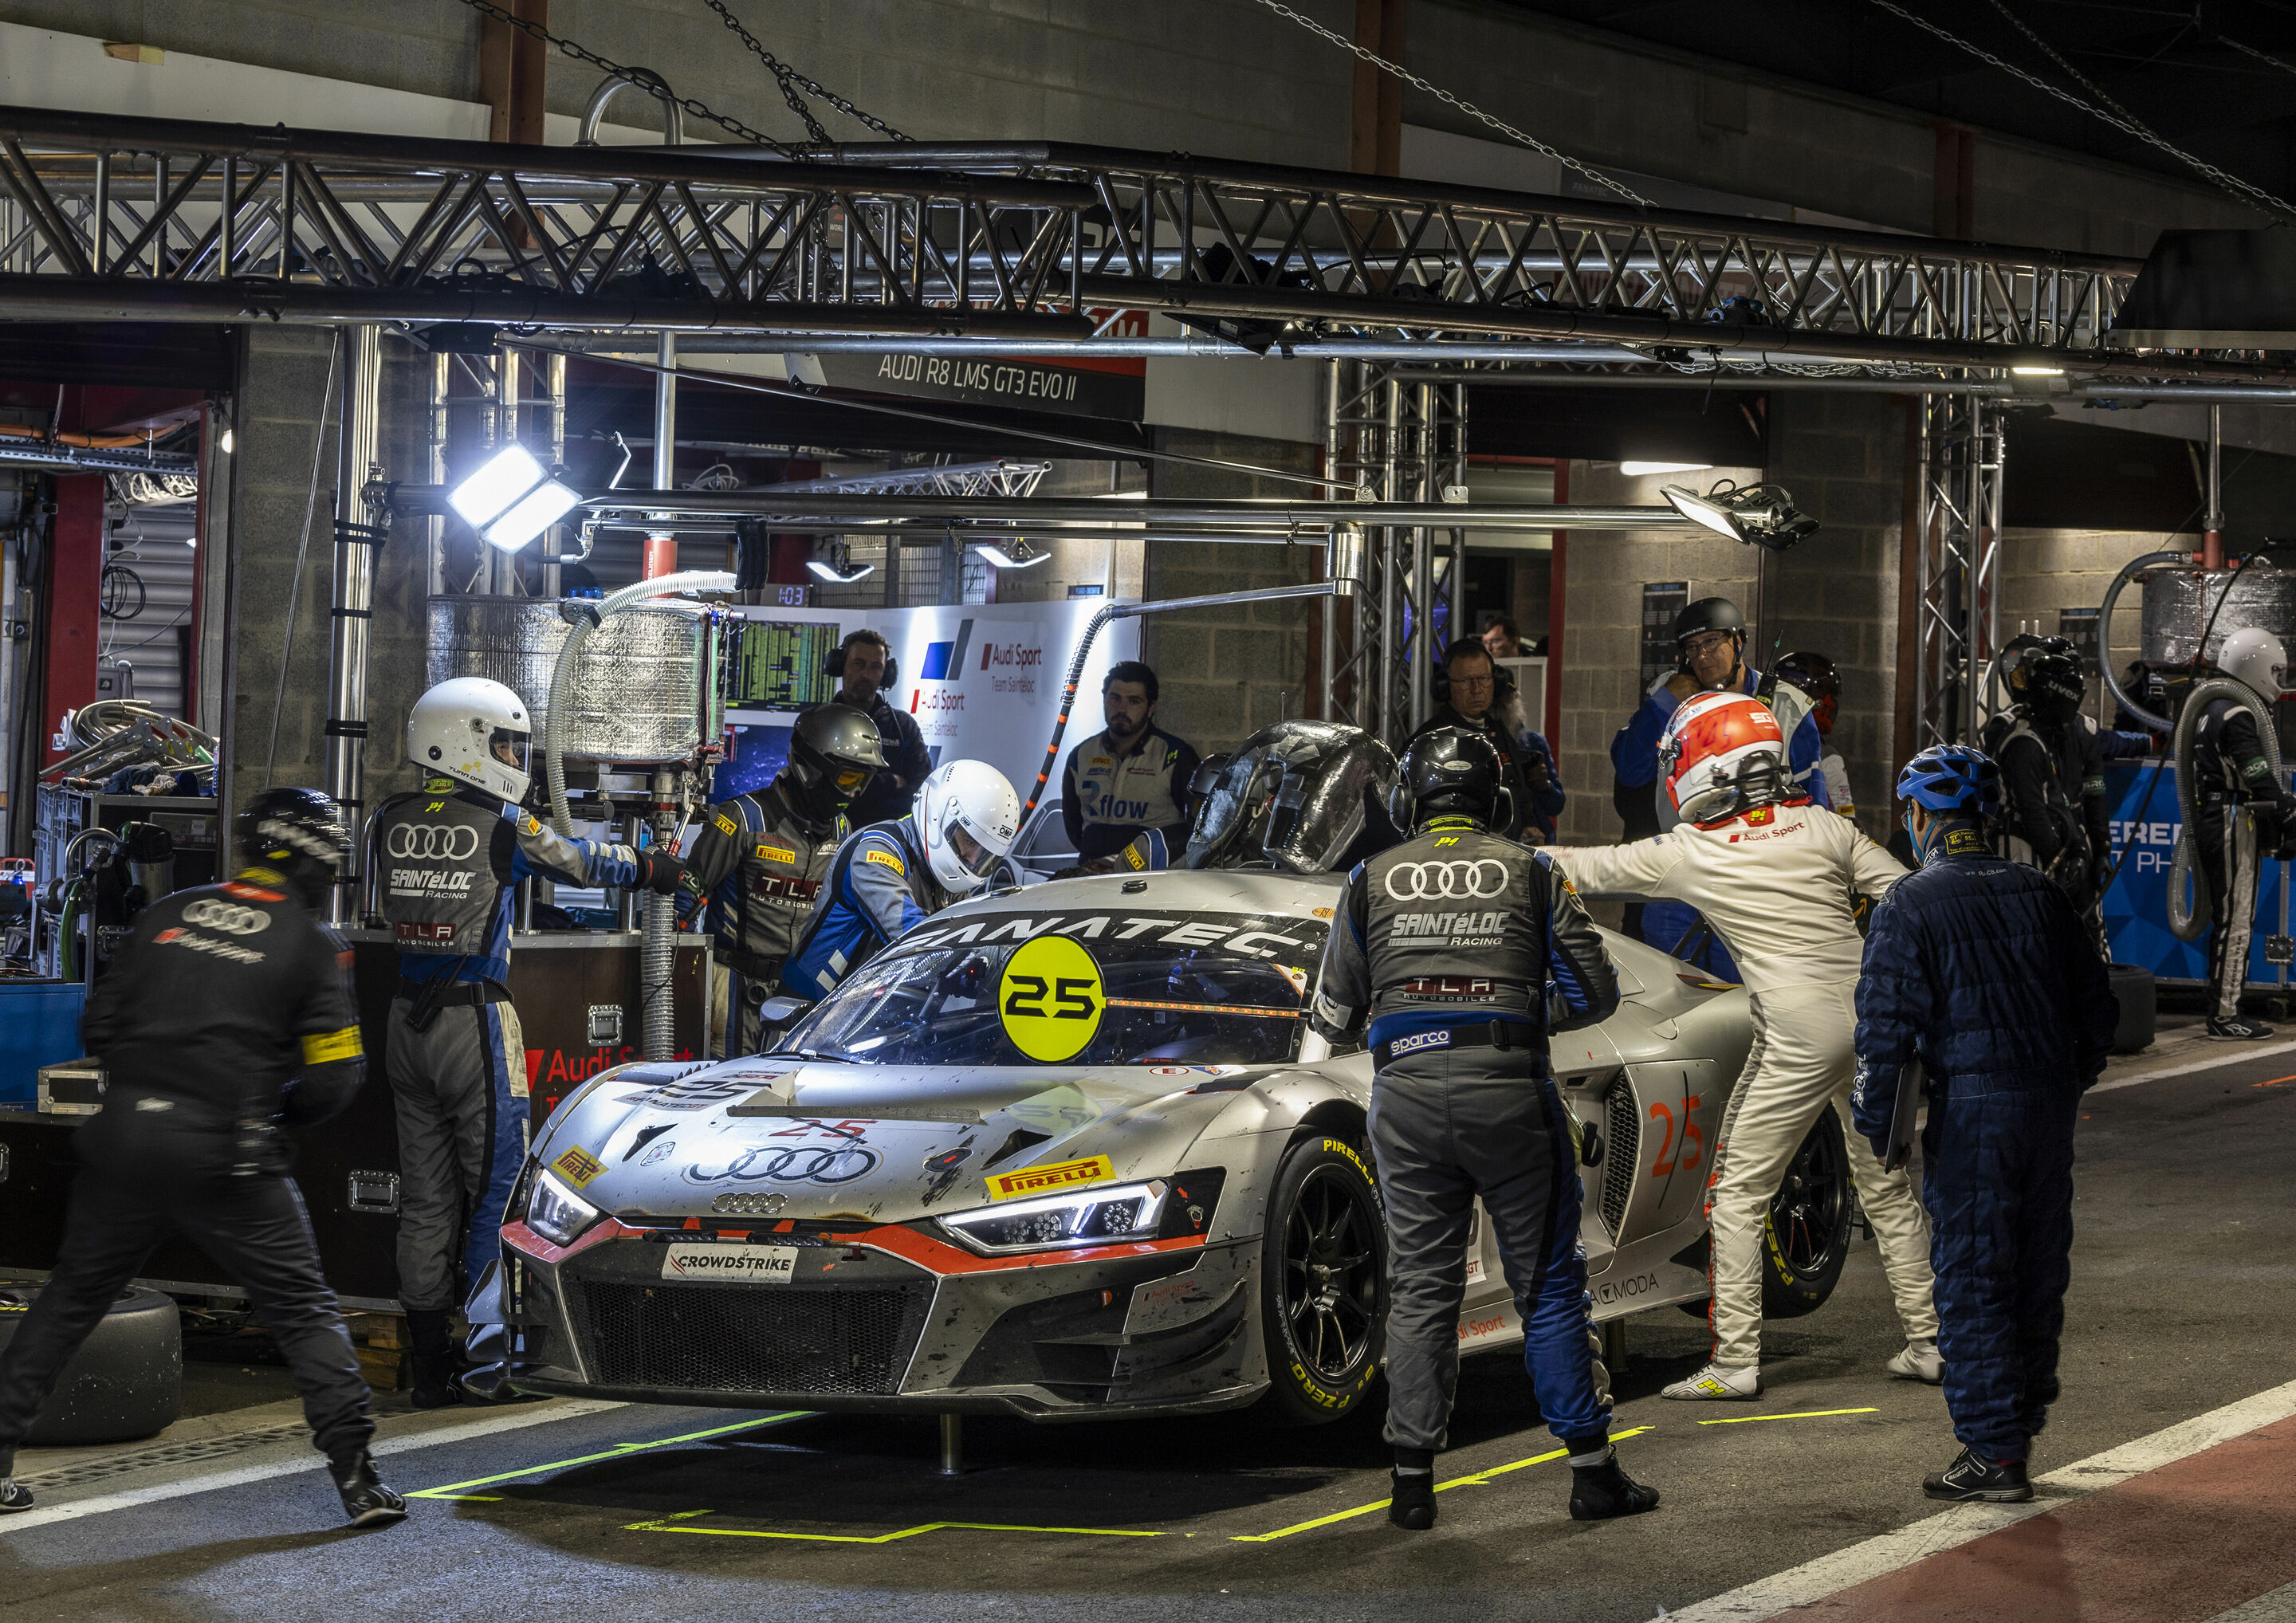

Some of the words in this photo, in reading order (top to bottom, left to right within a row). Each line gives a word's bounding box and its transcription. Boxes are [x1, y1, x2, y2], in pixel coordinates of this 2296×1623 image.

[1571, 182, 1608, 198] FANATEC
[878, 355, 922, 381] AUDI
[926, 358, 949, 385] R8
[953, 361, 991, 390] LMS
[994, 366, 1024, 394] GT3
[1028, 371, 1063, 399] EVO
[1066, 376, 1076, 400] II
[778, 587, 804, 605] 1:03
[993, 644, 1014, 666] Audi
[1016, 643, 1042, 670] Sport
[993, 677, 1008, 692] Team
[2048, 680, 2080, 702] uvex
[942, 690, 965, 715] Sport
[449, 765, 468, 777] TURN
[470, 775, 486, 784] ONE
[999, 827, 1012, 838] OMP
[1744, 831, 1770, 842] Audi
[1771, 822, 1805, 839] Sport
[758, 847, 793, 863] PIRELLI
[869, 852, 904, 875] PIRELLI
[426, 890, 468, 899] RACING
[399, 924, 451, 938] TLA
[1391, 912, 1511, 936] SAINTéLOC
[890, 916, 1305, 958] FANATEC
[1450, 937, 1503, 946] RACING
[1413, 978, 1490, 992] TLA
[1005, 974, 1096, 1020] 25
[1403, 993, 1496, 1002] AUTOMOBILES
[1391, 1031, 1449, 1054] sparco
[547, 1047, 611, 1083] Audi
[769, 1119, 879, 1138] 25
[1649, 1095, 1703, 1178] 25
[557, 1150, 600, 1183] PIRELLI
[1323, 1139, 1374, 1185] PIRELLI
[998, 1161, 1101, 1193] PIRELLI
[678, 1256, 792, 1271] CROWDSTRIKE
[1469, 1315, 1506, 1338] Sport
